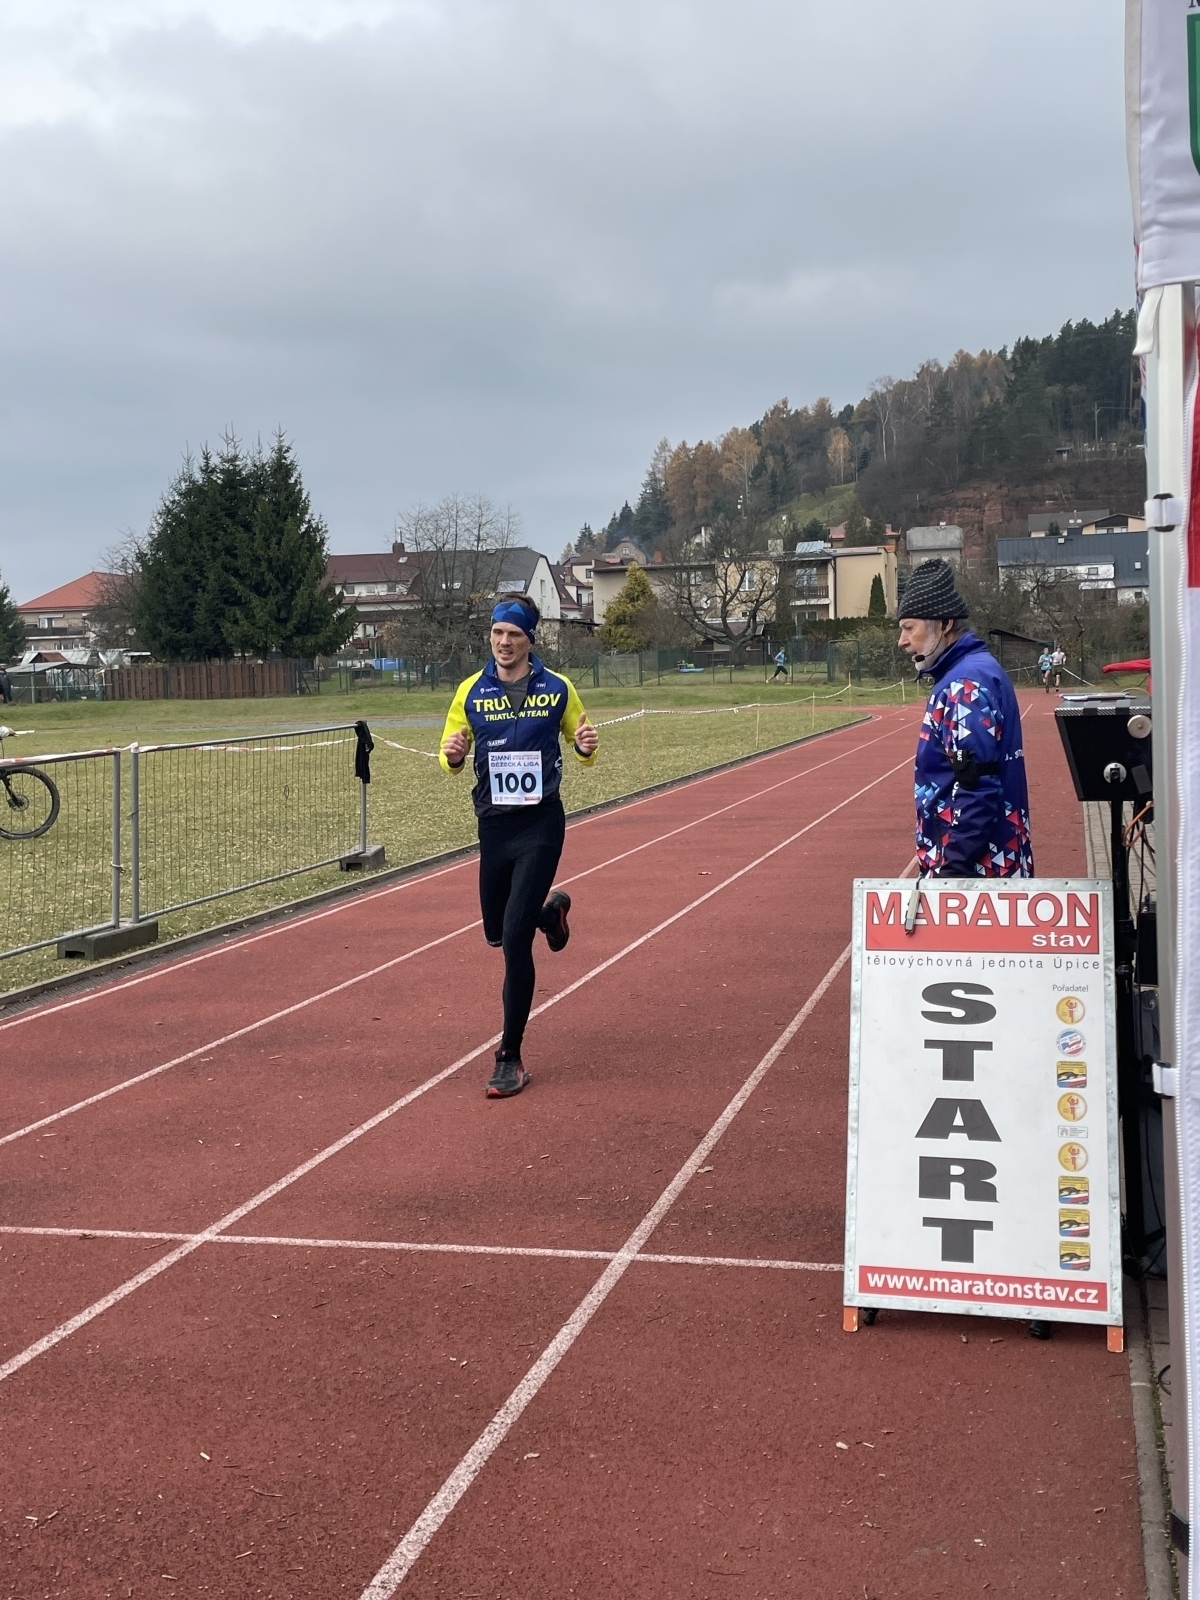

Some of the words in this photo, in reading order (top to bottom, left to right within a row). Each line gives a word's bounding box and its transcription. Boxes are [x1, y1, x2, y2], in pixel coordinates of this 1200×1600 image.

[527, 709, 549, 718] TEAM
[494, 772, 537, 793] 100
[866, 891, 1099, 927] MARATON
[1032, 931, 1092, 947] stav
[867, 955, 973, 968] tělovýchovná
[981, 957, 1044, 970] jednota
[1053, 956, 1100, 971] Úpice
[1052, 984, 1089, 993] Pořadatel
[914, 982, 1003, 1264] START
[866, 1272, 1099, 1304] www.maratonstav.cz
